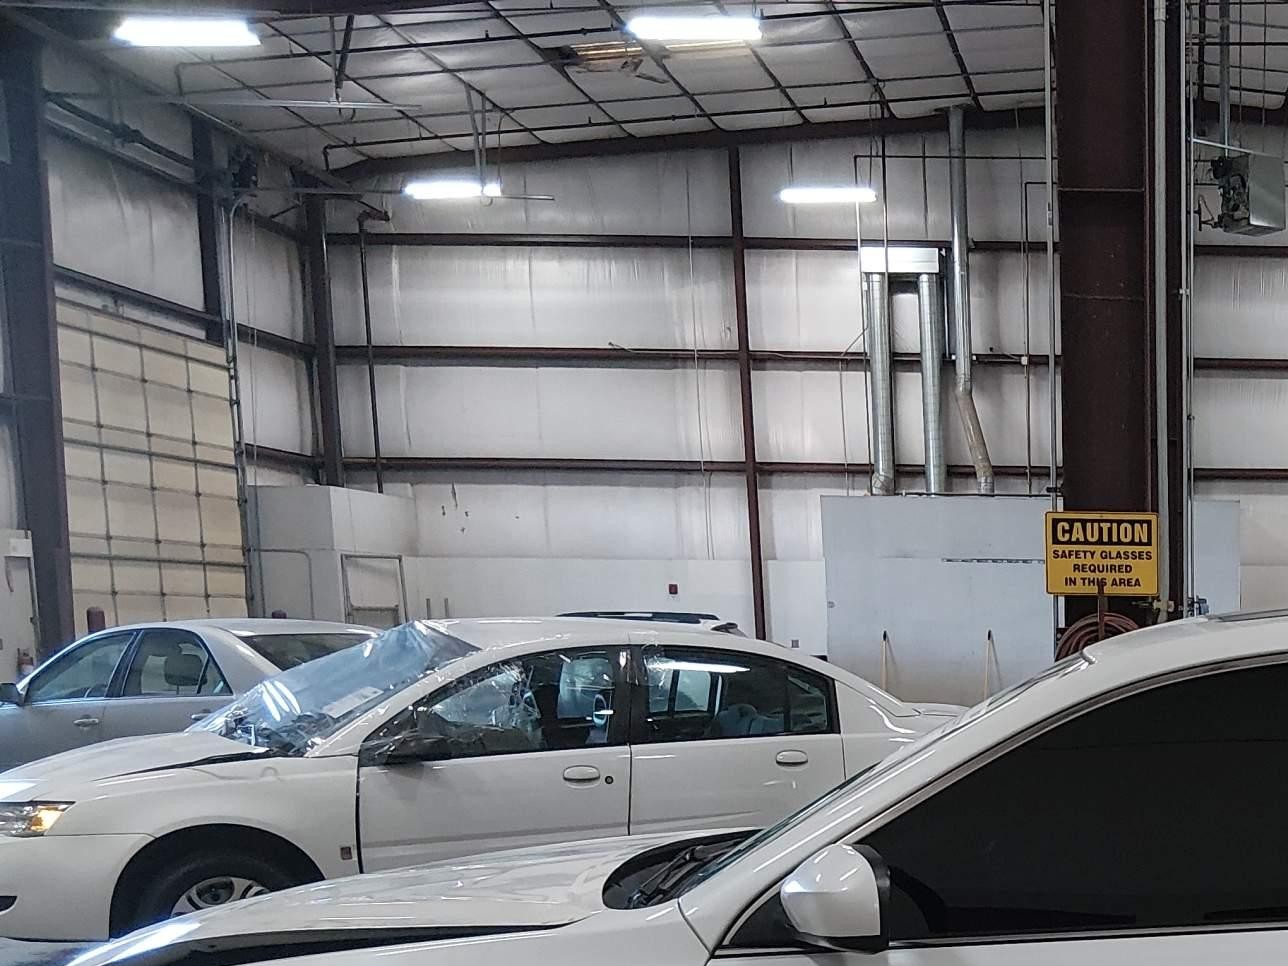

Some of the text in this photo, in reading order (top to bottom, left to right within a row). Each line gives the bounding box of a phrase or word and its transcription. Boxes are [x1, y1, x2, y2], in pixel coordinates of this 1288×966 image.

[1056, 521, 1148, 543] CAUTION
[1052, 549, 1152, 560] SAFETY GLASSES
[1073, 563, 1133, 573] REQUIRED
[1064, 577, 1141, 587] IN THIS AREA
